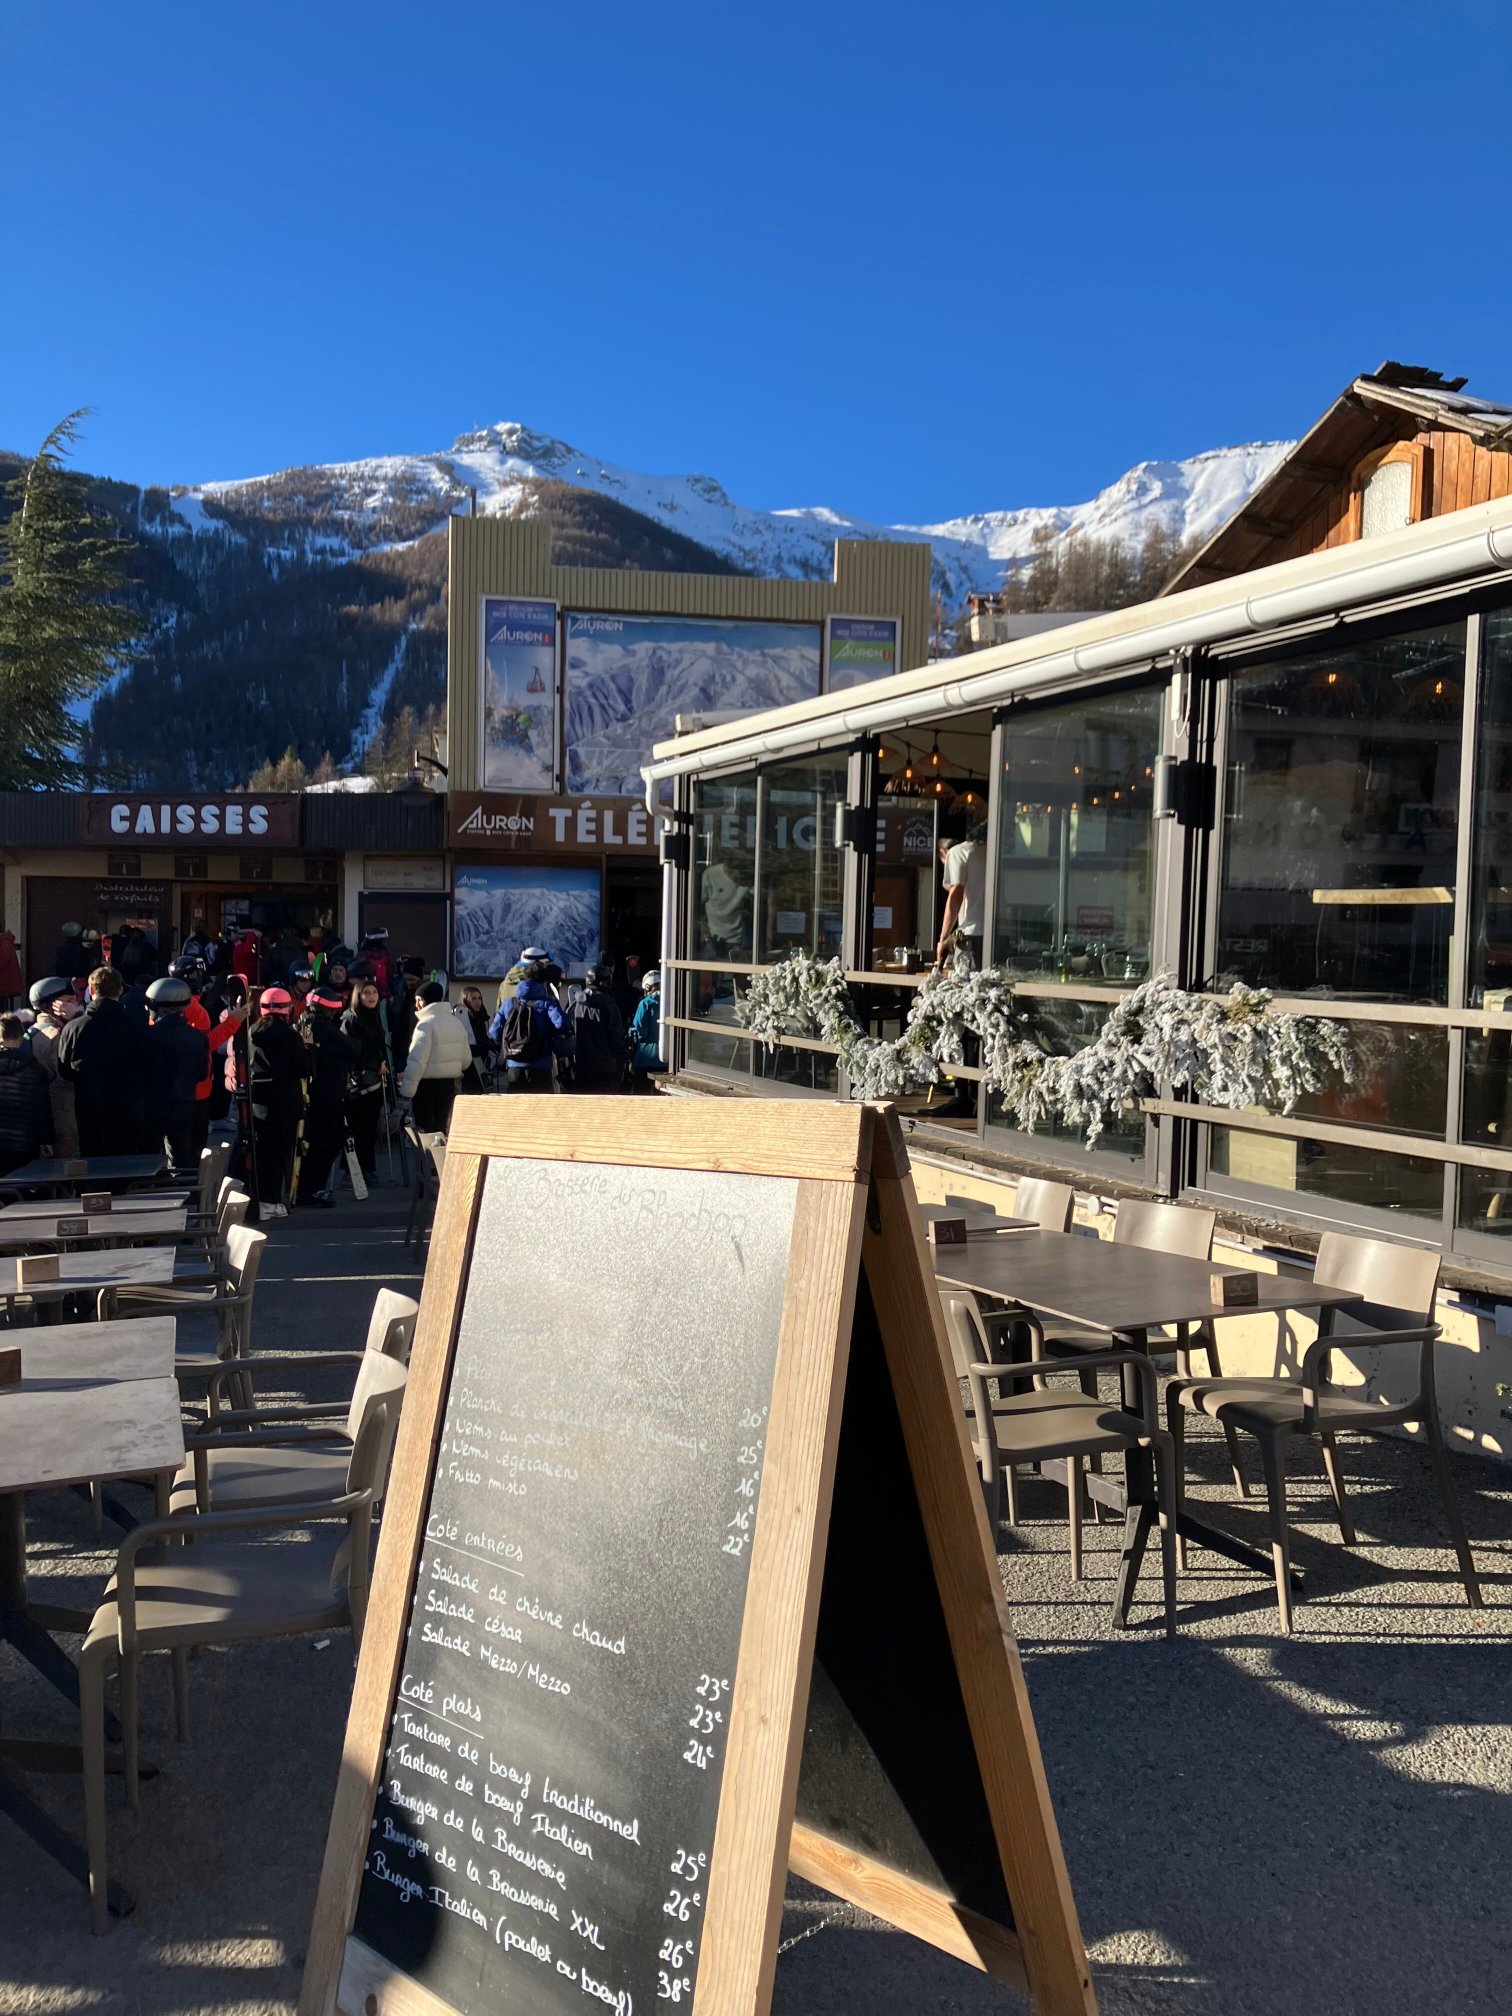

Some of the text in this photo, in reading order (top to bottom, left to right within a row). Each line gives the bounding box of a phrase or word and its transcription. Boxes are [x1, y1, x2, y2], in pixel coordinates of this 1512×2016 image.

[109, 804, 270, 835] CAISSES
[456, 804, 535, 833] AURON
[903, 836, 933, 848] NICE
[460, 1388, 503, 1414] Planche
[511, 1402, 528, 1418] de
[455, 1418, 492, 1440] Nems
[500, 1429, 518, 1443] au
[524, 1431, 570, 1450] poulet
[452, 1439, 489, 1460] Nems
[496, 1450, 579, 1481] végétariens
[488, 1478, 527, 1495] misto
[426, 1513, 524, 1562] Coté entrées
[424, 1589, 475, 1624] Salade
[484, 1614, 523, 1643] césar
[430, 1558, 479, 1594] Salade
[488, 1584, 508, 1605] de
[516, 1595, 564, 1630] chèvre
[572, 1619, 626, 1655] chaud
[421, 1623, 471, 1657] Salade
[400, 1674, 482, 1722] Coté plats
[396, 1743, 448, 1785] Tartare
[454, 1775, 474, 1796] de
[530, 1813, 594, 1861] Italien
[400, 1713, 451, 1752] Tartare
[459, 1741, 479, 1765] de
[542, 1776, 641, 1846] traditionnel
[389, 1780, 438, 1825] Burger
[443, 1809, 464, 1833] de
[471, 1818, 486, 1845] la
[491, 1827, 567, 1891] Brasserie
[382, 1817, 430, 1858] Burger
[434, 1846, 457, 1873] de
[466, 1859, 482, 1886] la
[486, 1868, 560, 1922] Brasserie
[570, 1909, 606, 1951] XXL
[371, 1850, 424, 1903] Burger
[428, 1886, 489, 1932] Italien
[557, 1959, 578, 1981] ou
